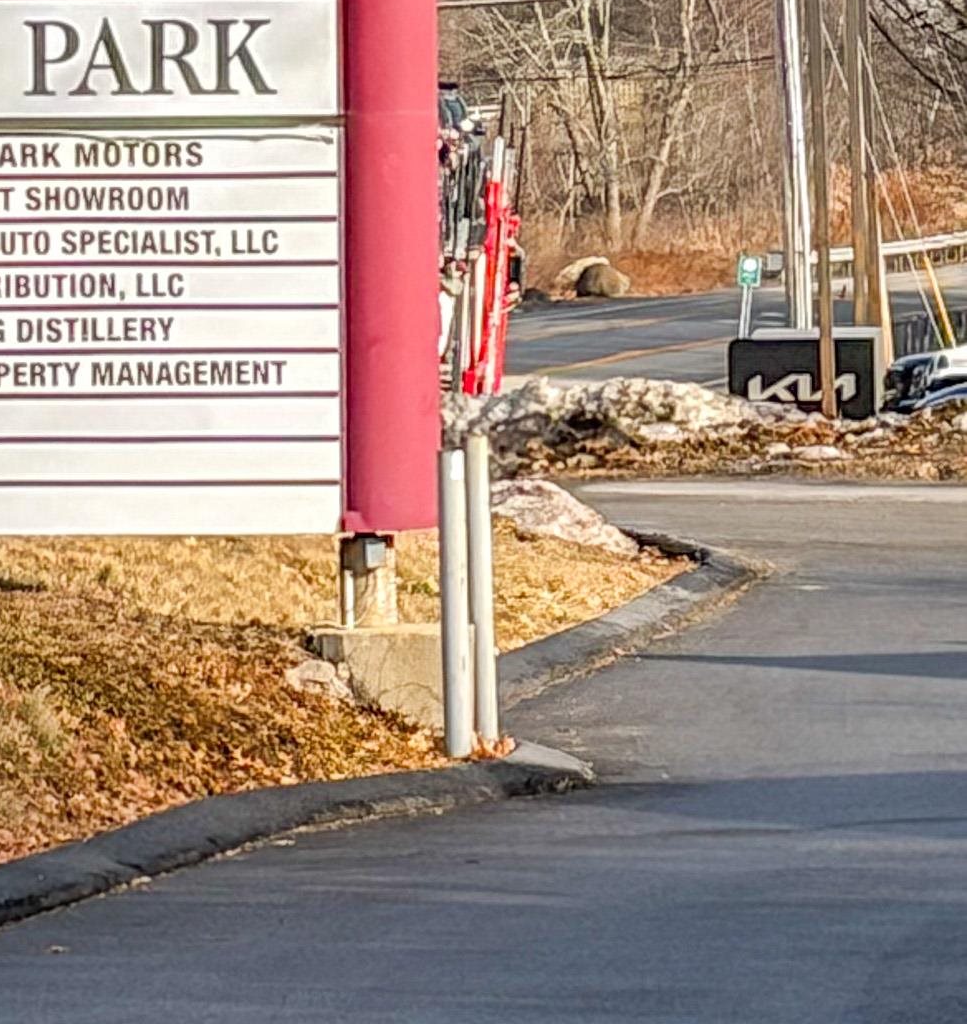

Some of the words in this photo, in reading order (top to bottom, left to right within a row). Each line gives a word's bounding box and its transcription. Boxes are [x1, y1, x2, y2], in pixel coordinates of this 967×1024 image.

[24, 17, 277, 96] PARK
[75, 142, 203, 168] MOTORS
[26, 186, 189, 211] SHOWROOM
[62, 230, 221, 259] SPECIALIST,
[231, 229, 278, 254] LLC
[136, 272, 184, 297] LLC
[17, 317, 173, 343] DISTILLERY
[91, 360, 287, 386] MANAGEMENT
